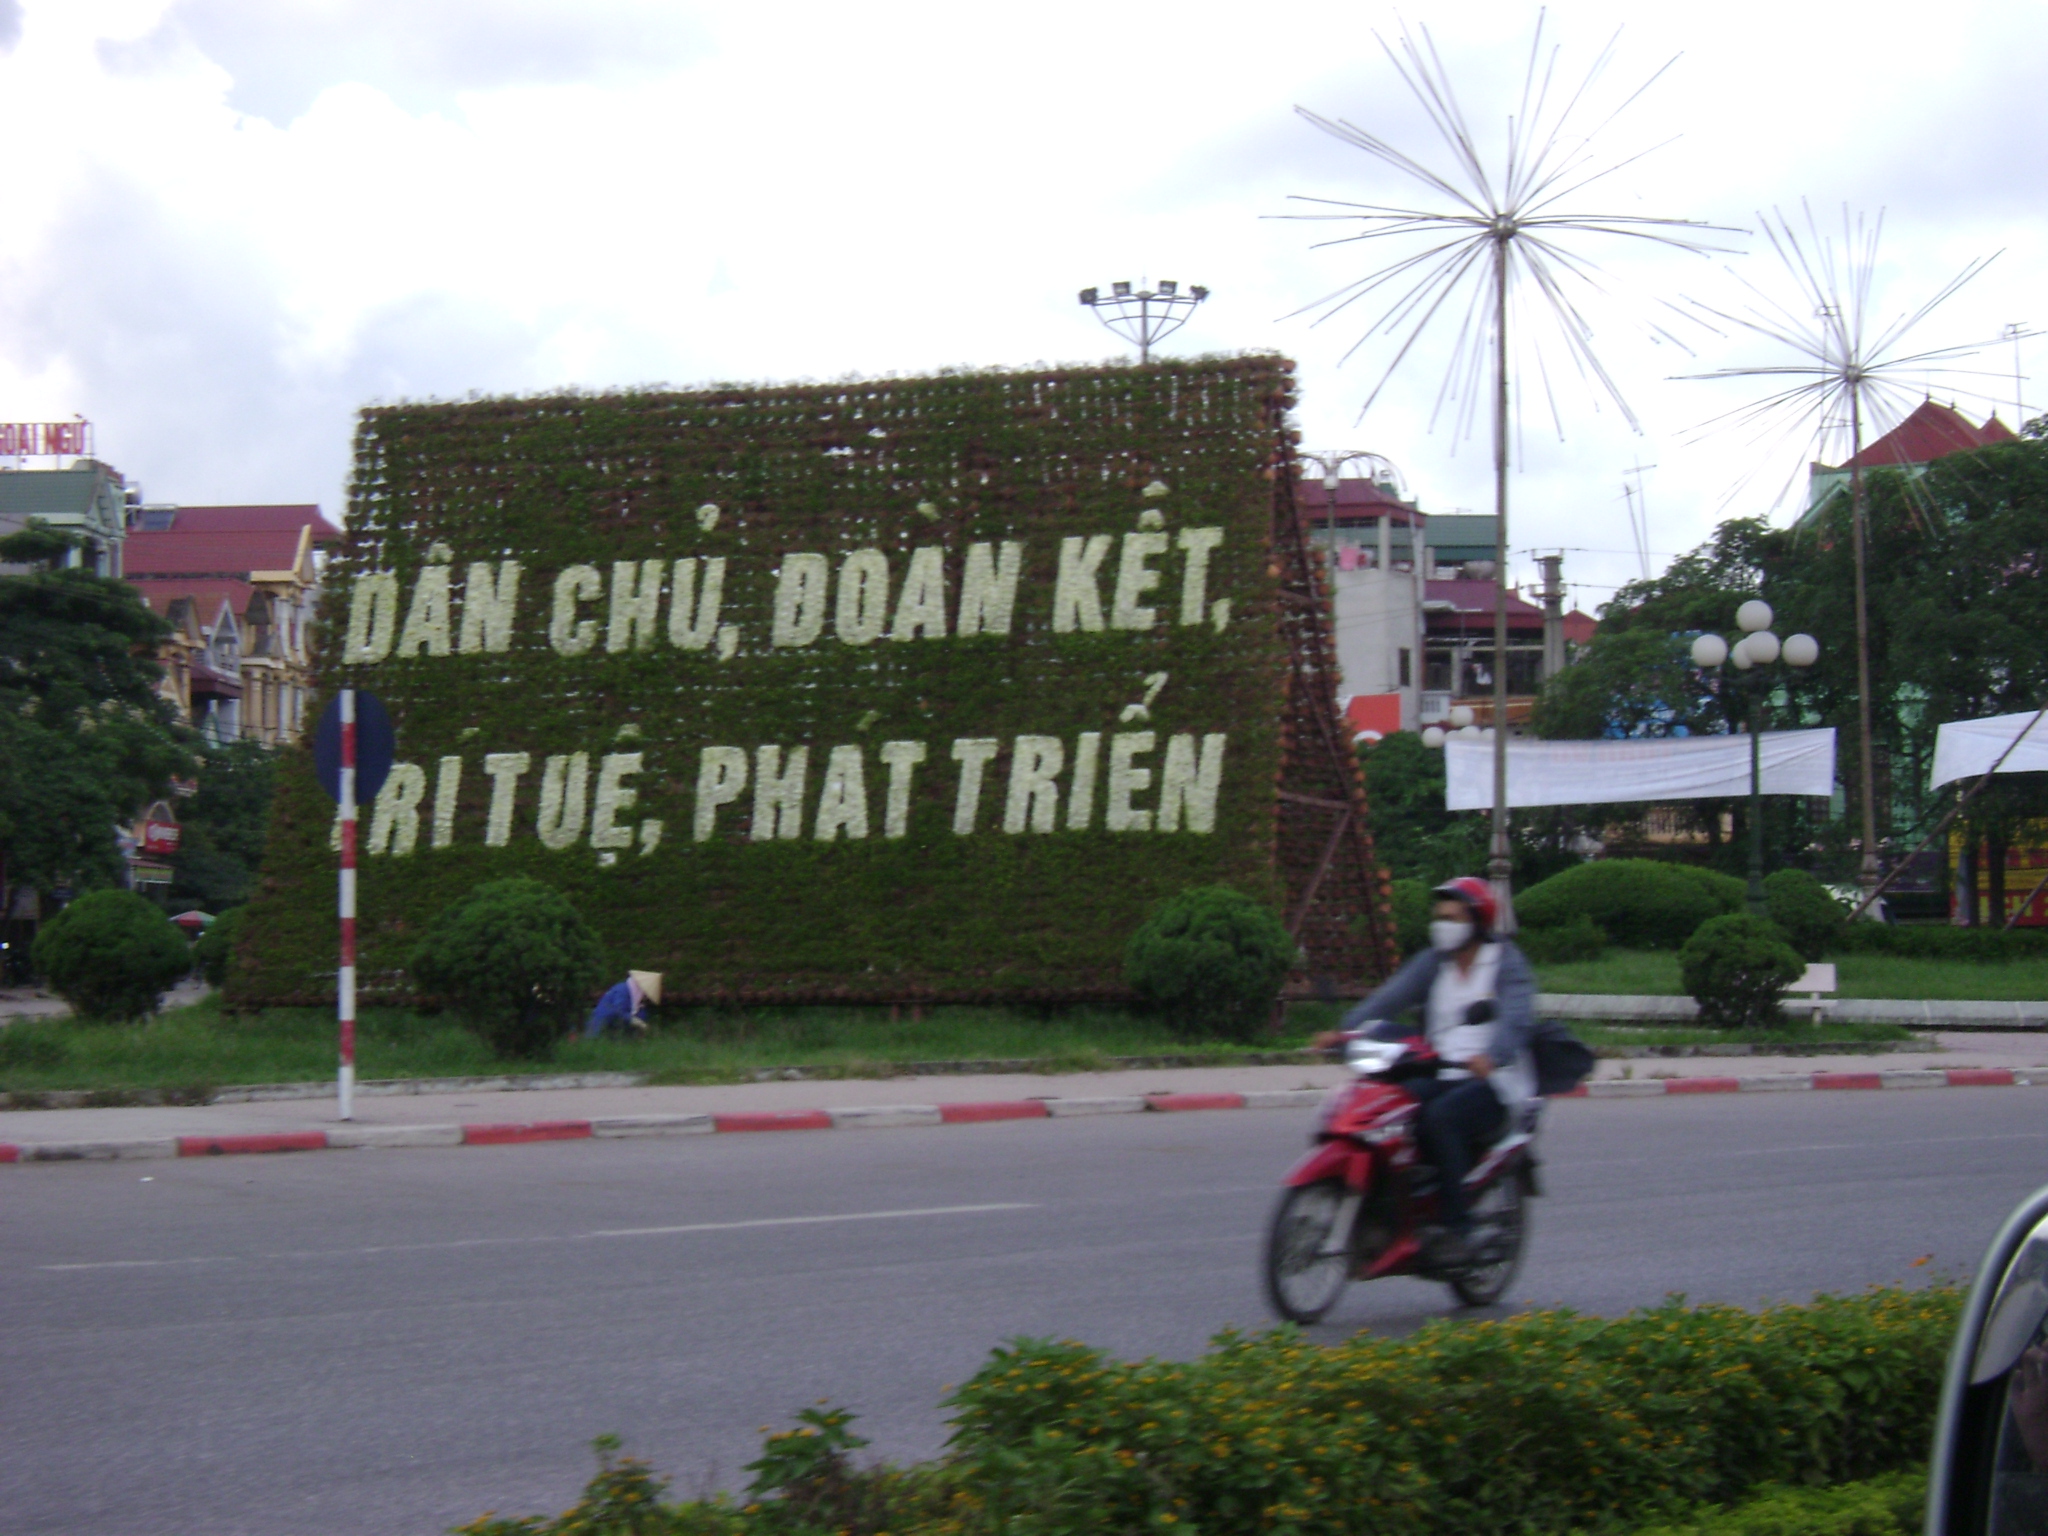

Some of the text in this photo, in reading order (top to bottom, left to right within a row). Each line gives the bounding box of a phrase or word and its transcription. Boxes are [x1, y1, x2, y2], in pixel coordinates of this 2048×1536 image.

[343, 481, 1232, 665] DÂN CHỦ, ĐOÀN KẾT,
[484, 724, 663, 867] TUỆ,
[692, 709, 928, 844] PHÁT
[951, 671, 1227, 835] TRIỂN
